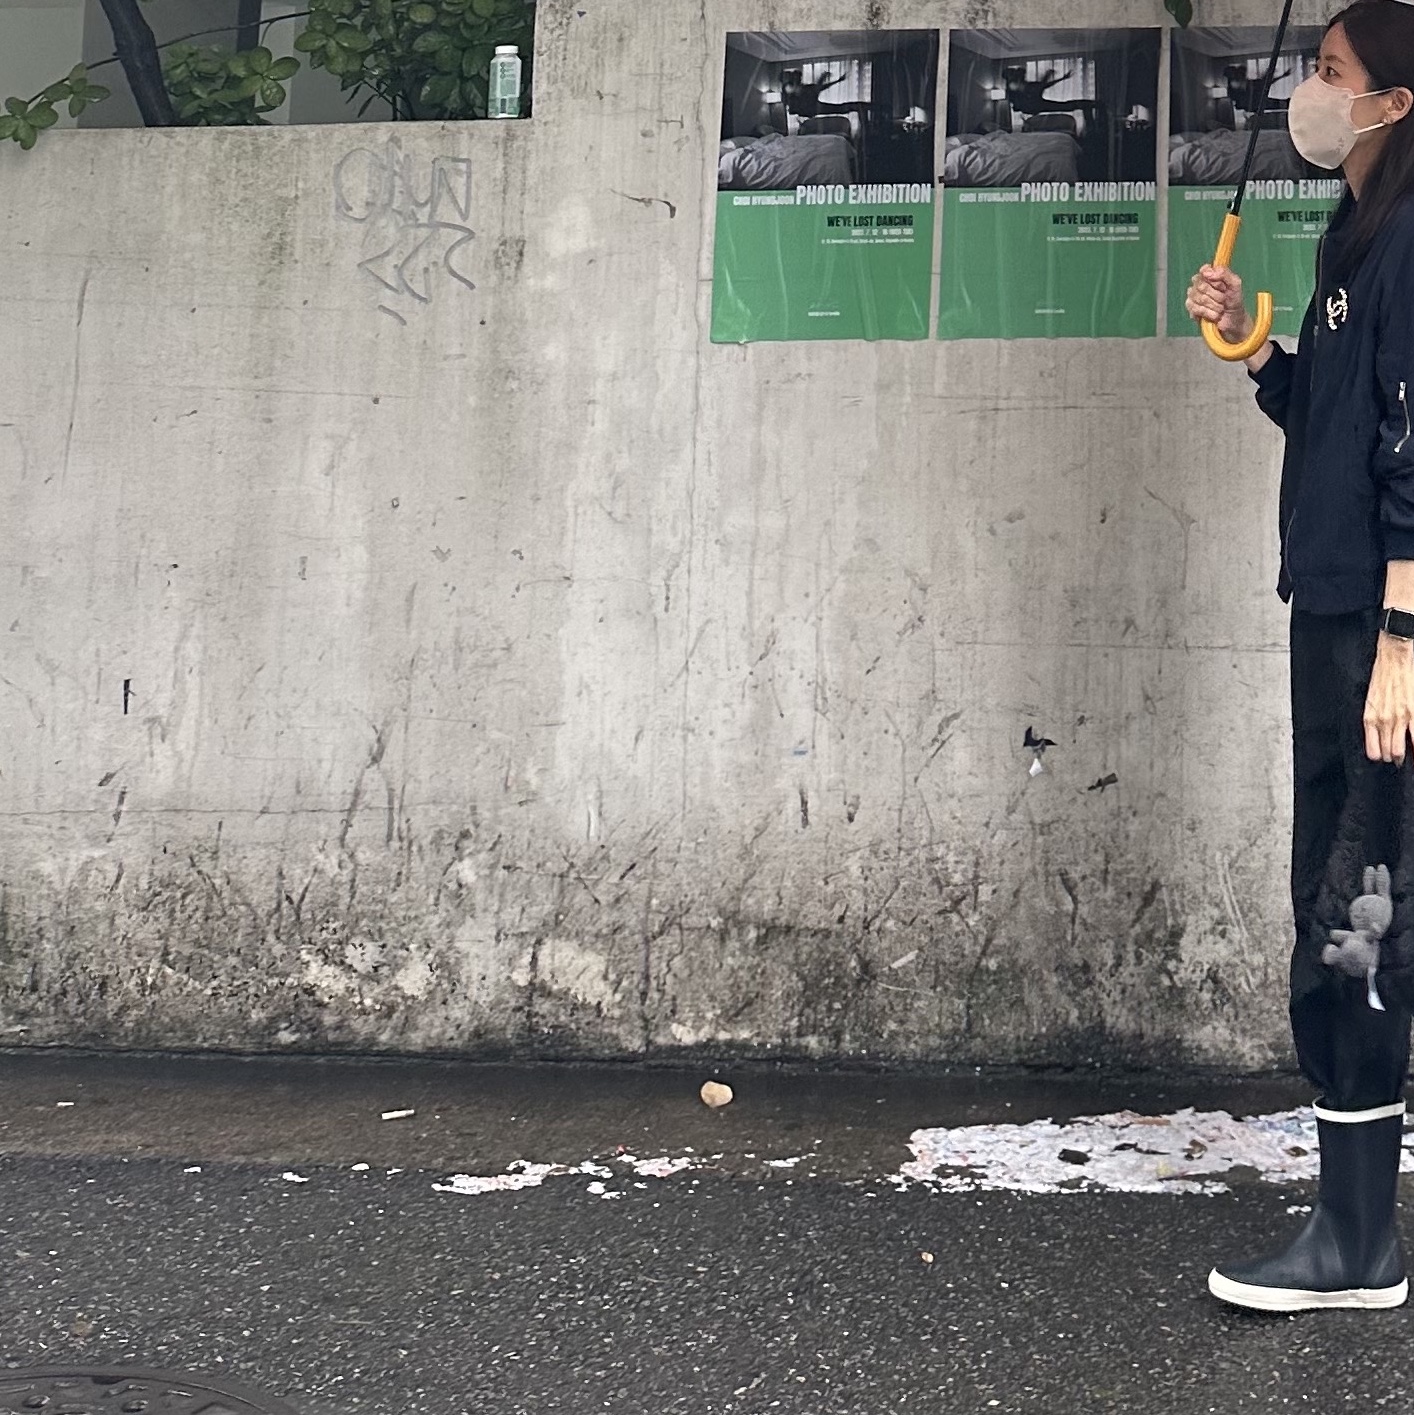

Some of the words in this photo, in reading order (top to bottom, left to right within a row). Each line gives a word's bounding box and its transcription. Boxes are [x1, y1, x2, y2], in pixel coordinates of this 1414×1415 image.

[796, 185, 845, 205] PHOTO
[848, 184, 931, 204] EXHIBITION
[1021, 182, 1070, 202] PHOTO
[1074, 181, 1156, 202] EXHIBITION
[1244, 180, 1294, 200] PHOTO
[1299, 179, 1344, 199] EXHIB
[827, 215, 852, 227] WE'VE
[853, 215, 874, 227] LOST
[876, 214, 914, 227] DANCING
[1052, 213, 1078, 225] WE'VE
[1080, 213, 1101, 224] LOST
[1304, 211, 1326, 222] LOST
